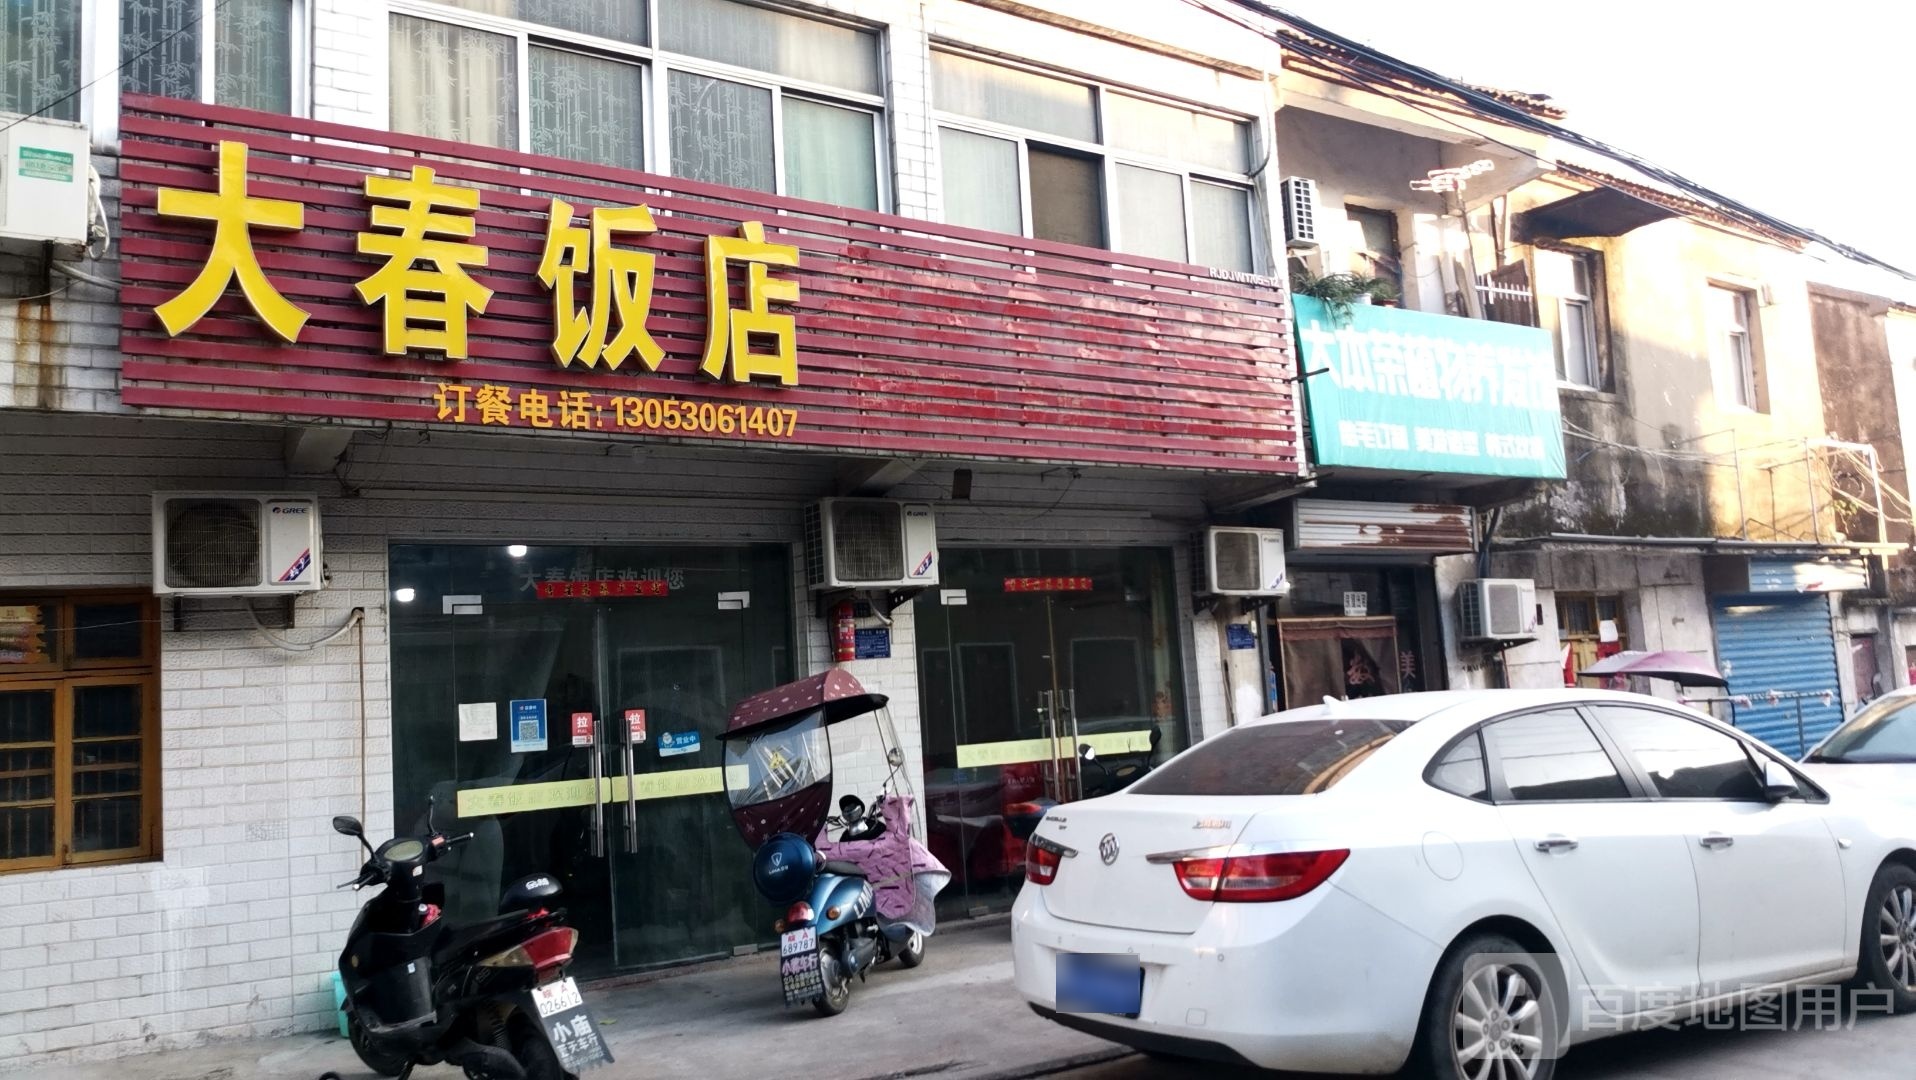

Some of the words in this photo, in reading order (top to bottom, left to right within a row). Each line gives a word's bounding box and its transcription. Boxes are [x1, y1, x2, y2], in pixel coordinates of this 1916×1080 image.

[154, 140, 800, 387] 大春饭店
[576, 716, 588, 728] 拉
[628, 713, 641, 725] 拉
[675, 734, 697, 745] 营业中
